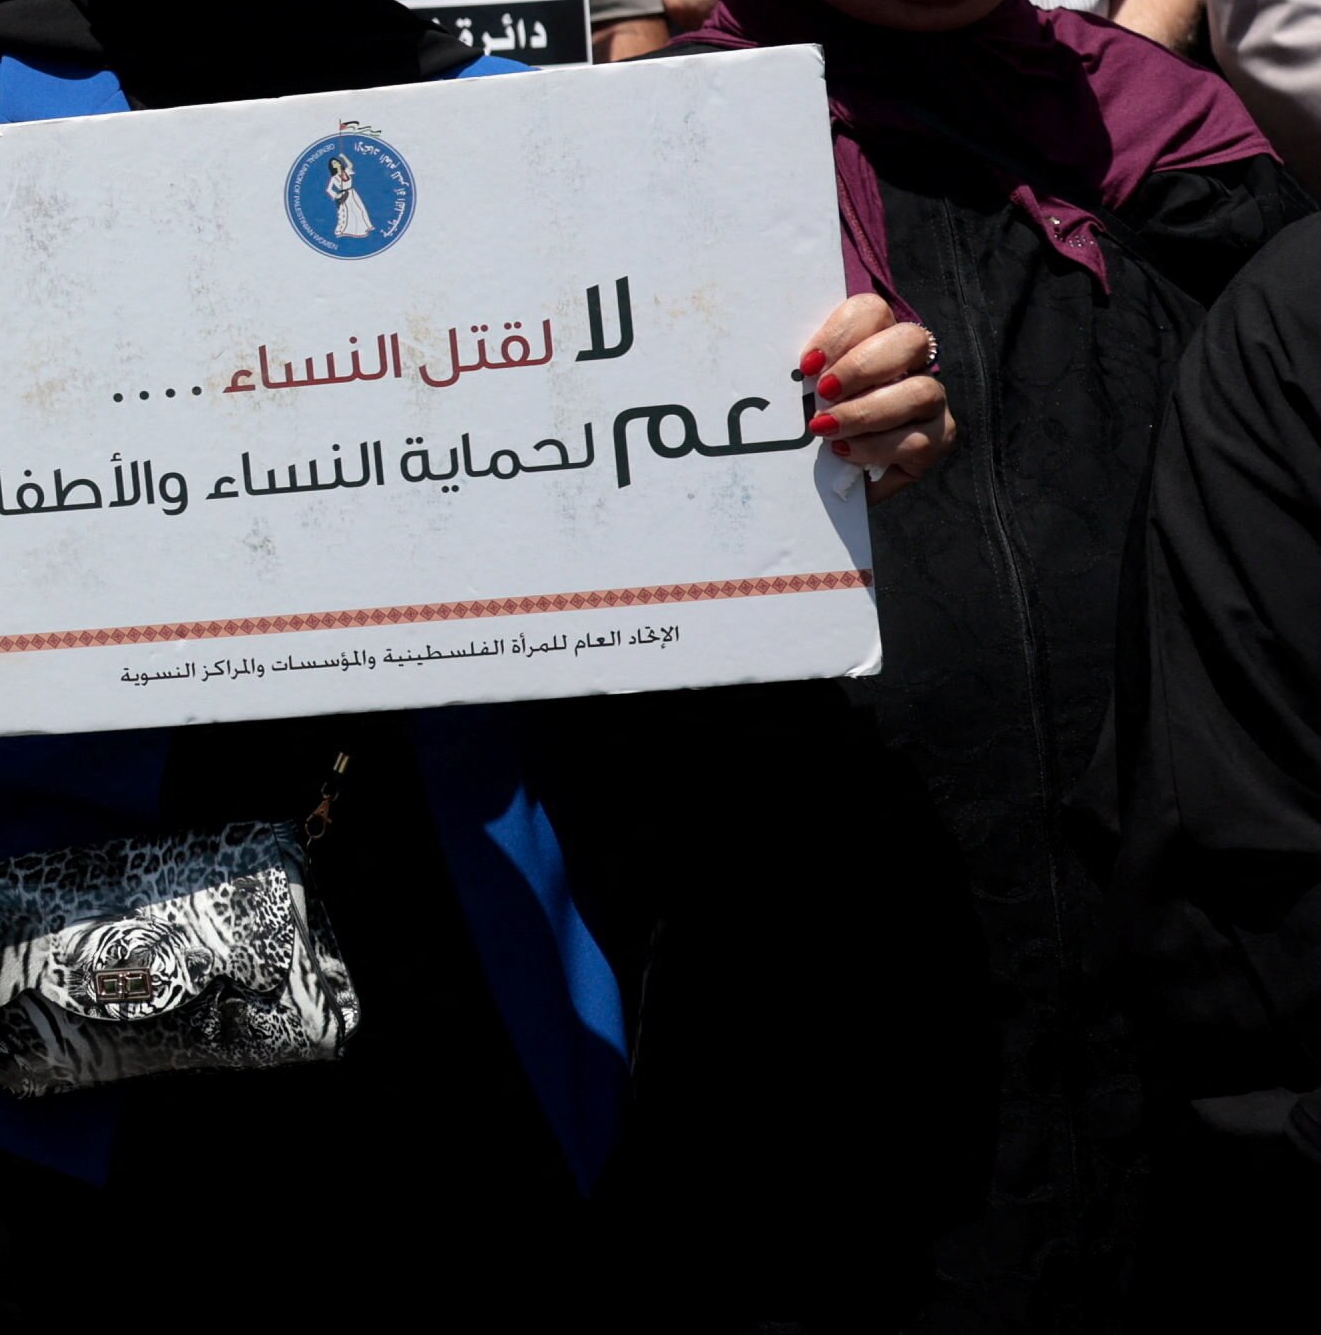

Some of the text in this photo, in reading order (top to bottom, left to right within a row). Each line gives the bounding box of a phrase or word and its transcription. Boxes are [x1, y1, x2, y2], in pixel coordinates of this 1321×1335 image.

[576, 276, 633, 361] لا
[226, 335, 401, 393] النساء
[421, 322, 553, 387] لقتل
[613, 368, 816, 489] نعم
[206, 441, 384, 499] النساء
[401, 423, 594, 493] لحماية
[271, 649, 376, 672] والمؤسسات
[383, 638, 504, 667] الفلسطينية
[512, 633, 567, 658] للمرأة
[575, 630, 621, 656] العام
[120, 662, 196, 687] النسوية
[201, 658, 264, 682] والمراكز
